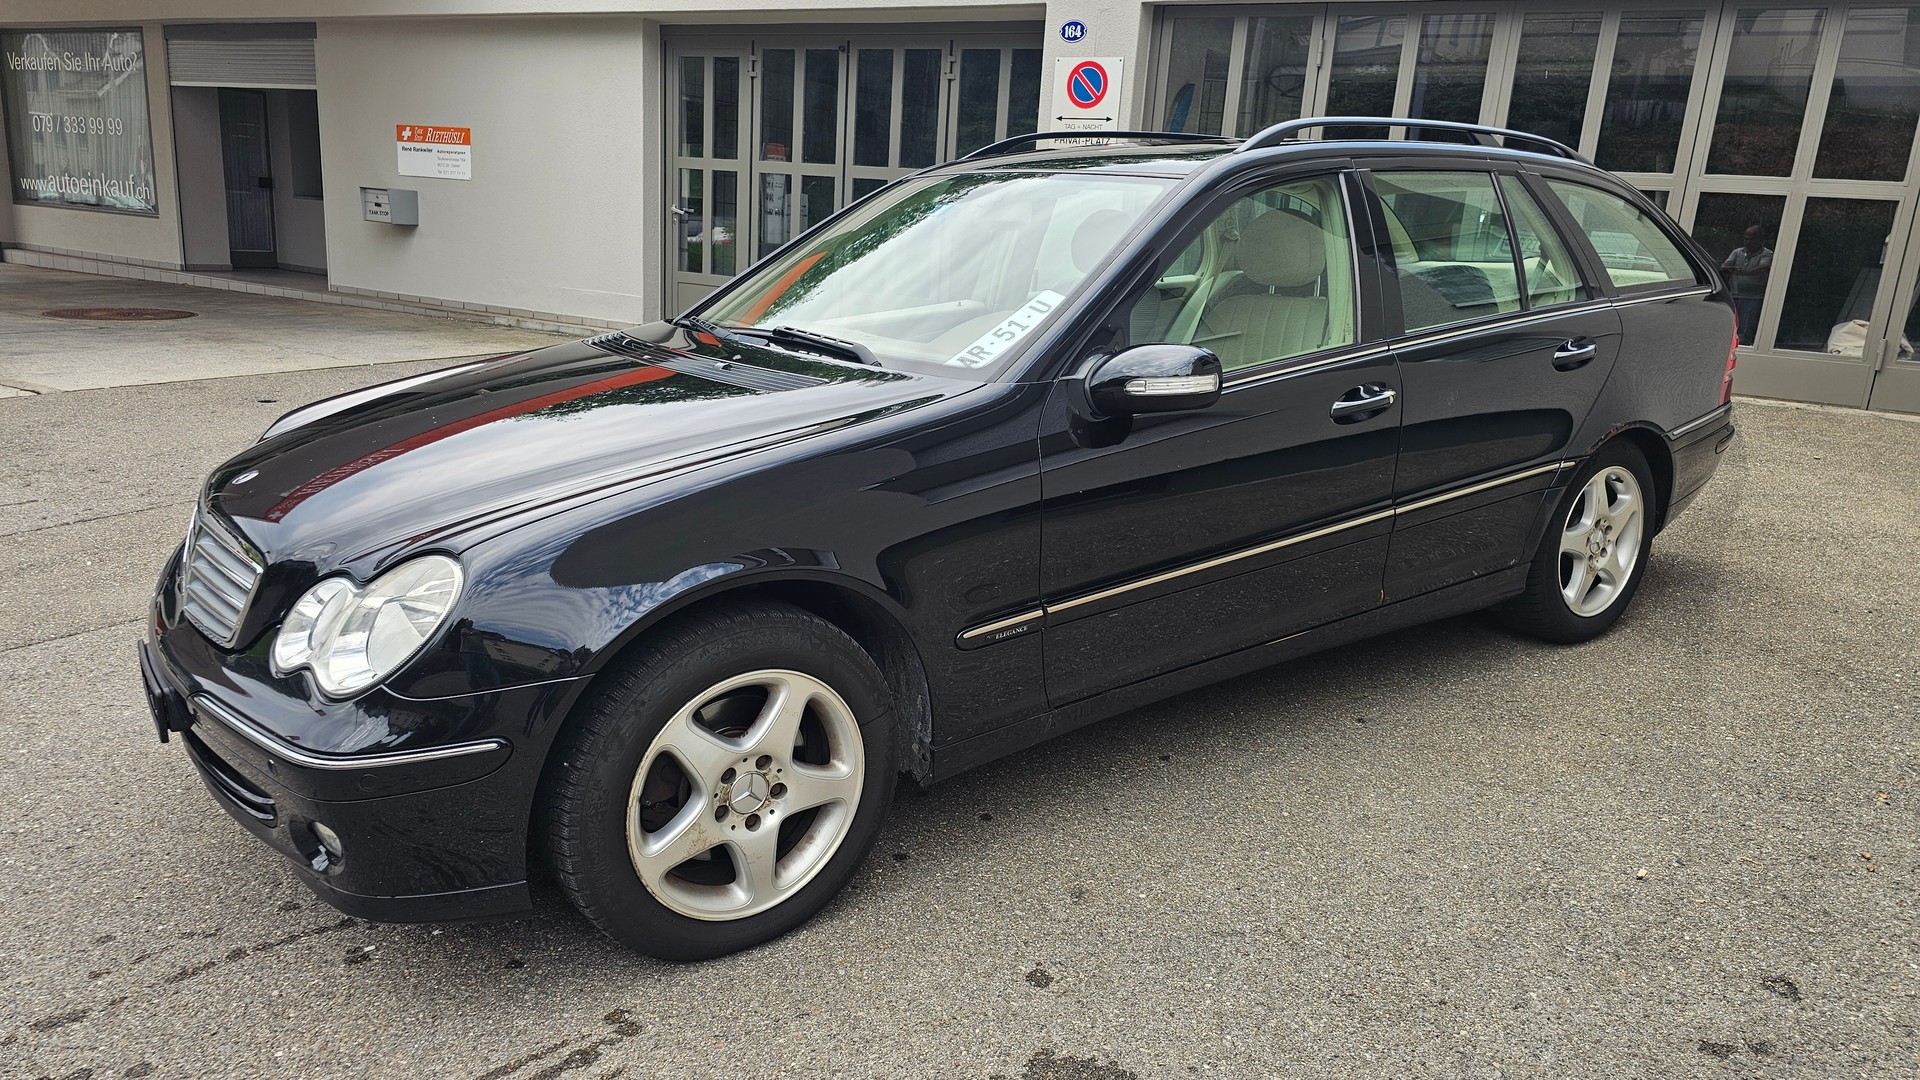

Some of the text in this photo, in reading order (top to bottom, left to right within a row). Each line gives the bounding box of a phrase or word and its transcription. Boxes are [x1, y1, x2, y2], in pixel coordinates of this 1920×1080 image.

[1064, 25, 1082, 38] 164
[7, 51, 138, 72] Verkaufen Sie Ihr Auto?
[32, 115, 53, 133] 079
[64, 116, 86, 134] 333
[89, 117, 104, 135] 99
[107, 118, 123, 136] 99
[425, 127, 465, 144] RIETHÜSLI
[20, 172, 150, 200] www.autoeinkauf.ch
[995, 626, 1028, 640] ELEGANCE
